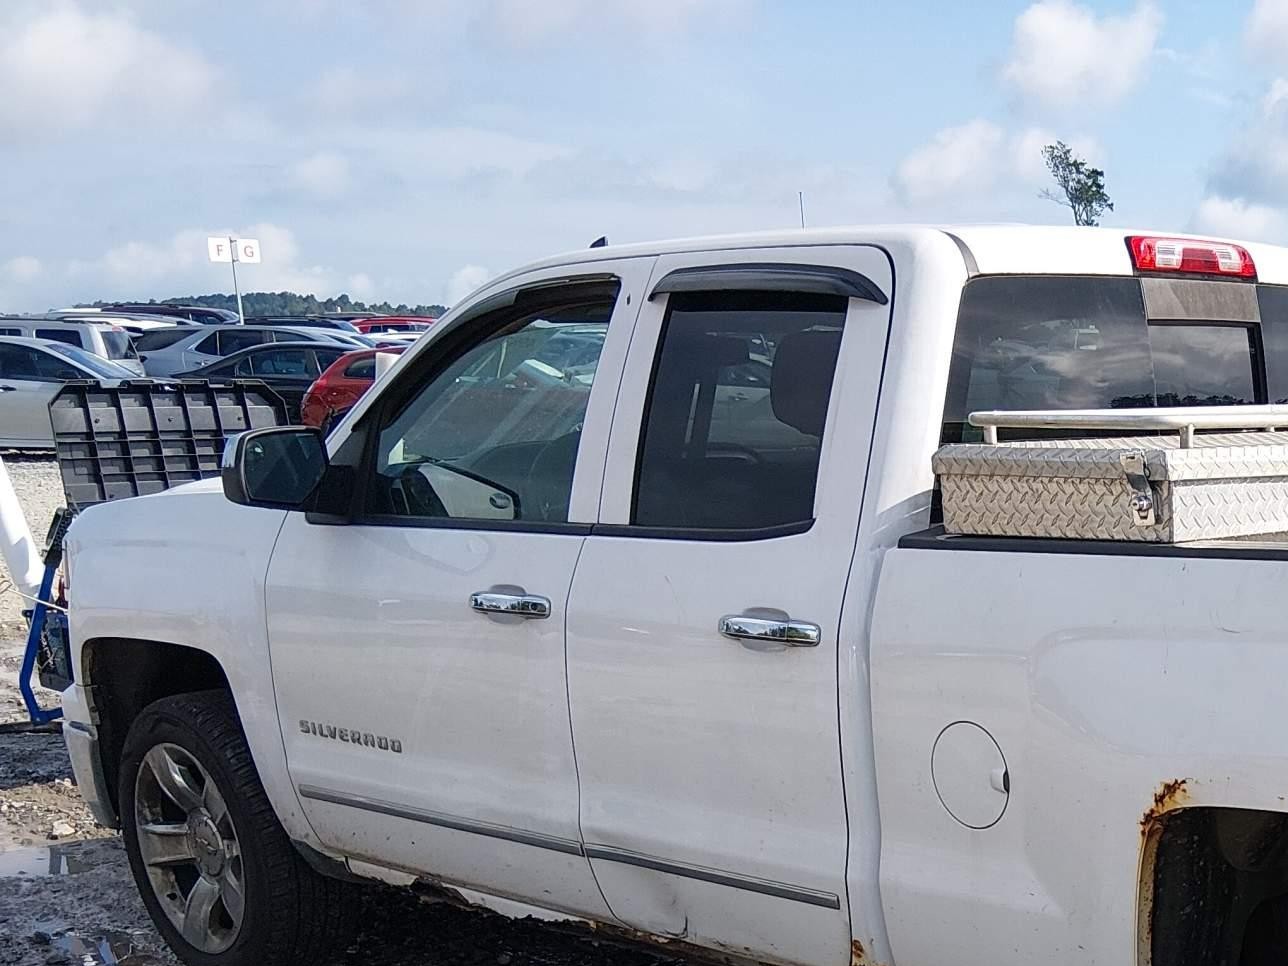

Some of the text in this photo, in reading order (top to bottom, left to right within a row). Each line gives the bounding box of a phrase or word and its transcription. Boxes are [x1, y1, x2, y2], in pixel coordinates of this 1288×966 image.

[216, 244, 223, 256] F
[244, 245, 254, 257] G
[299, 719, 402, 753] SILVERADO
